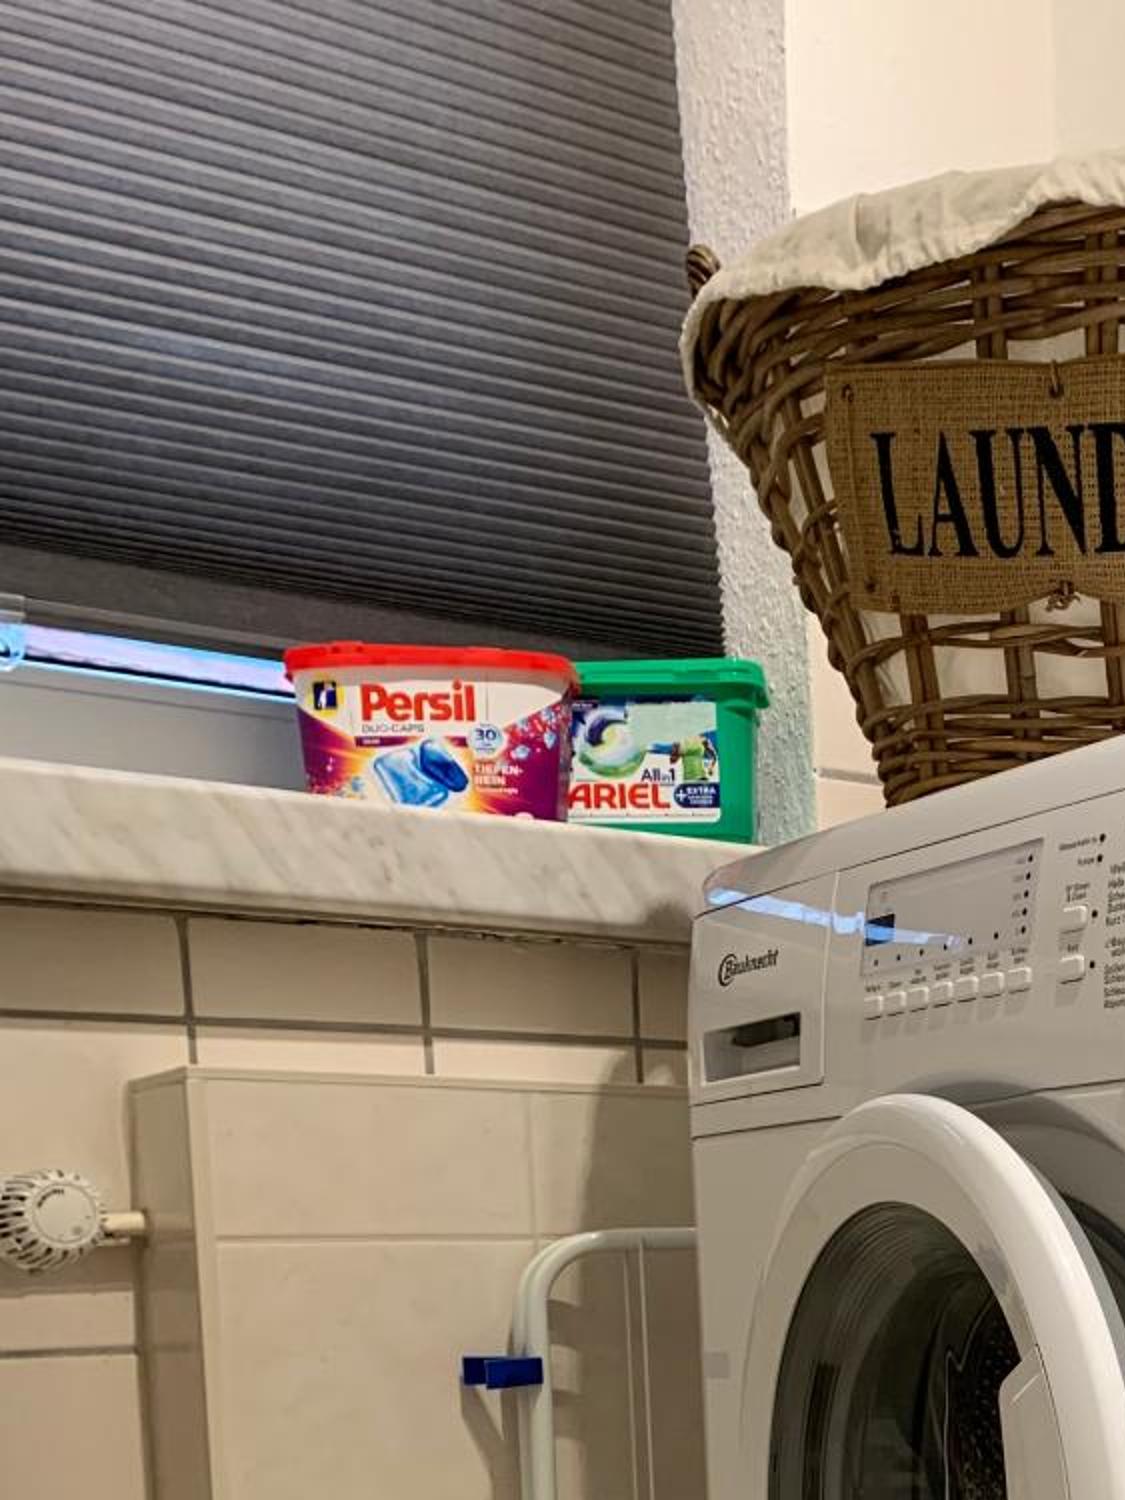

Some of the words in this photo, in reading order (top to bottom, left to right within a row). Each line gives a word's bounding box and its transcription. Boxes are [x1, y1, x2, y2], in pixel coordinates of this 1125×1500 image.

[360, 678, 476, 722] Persil
[361, 723, 425, 733] DUO-CAPS
[475, 728, 497, 740] 30
[567, 782, 671, 809] ARIEL
